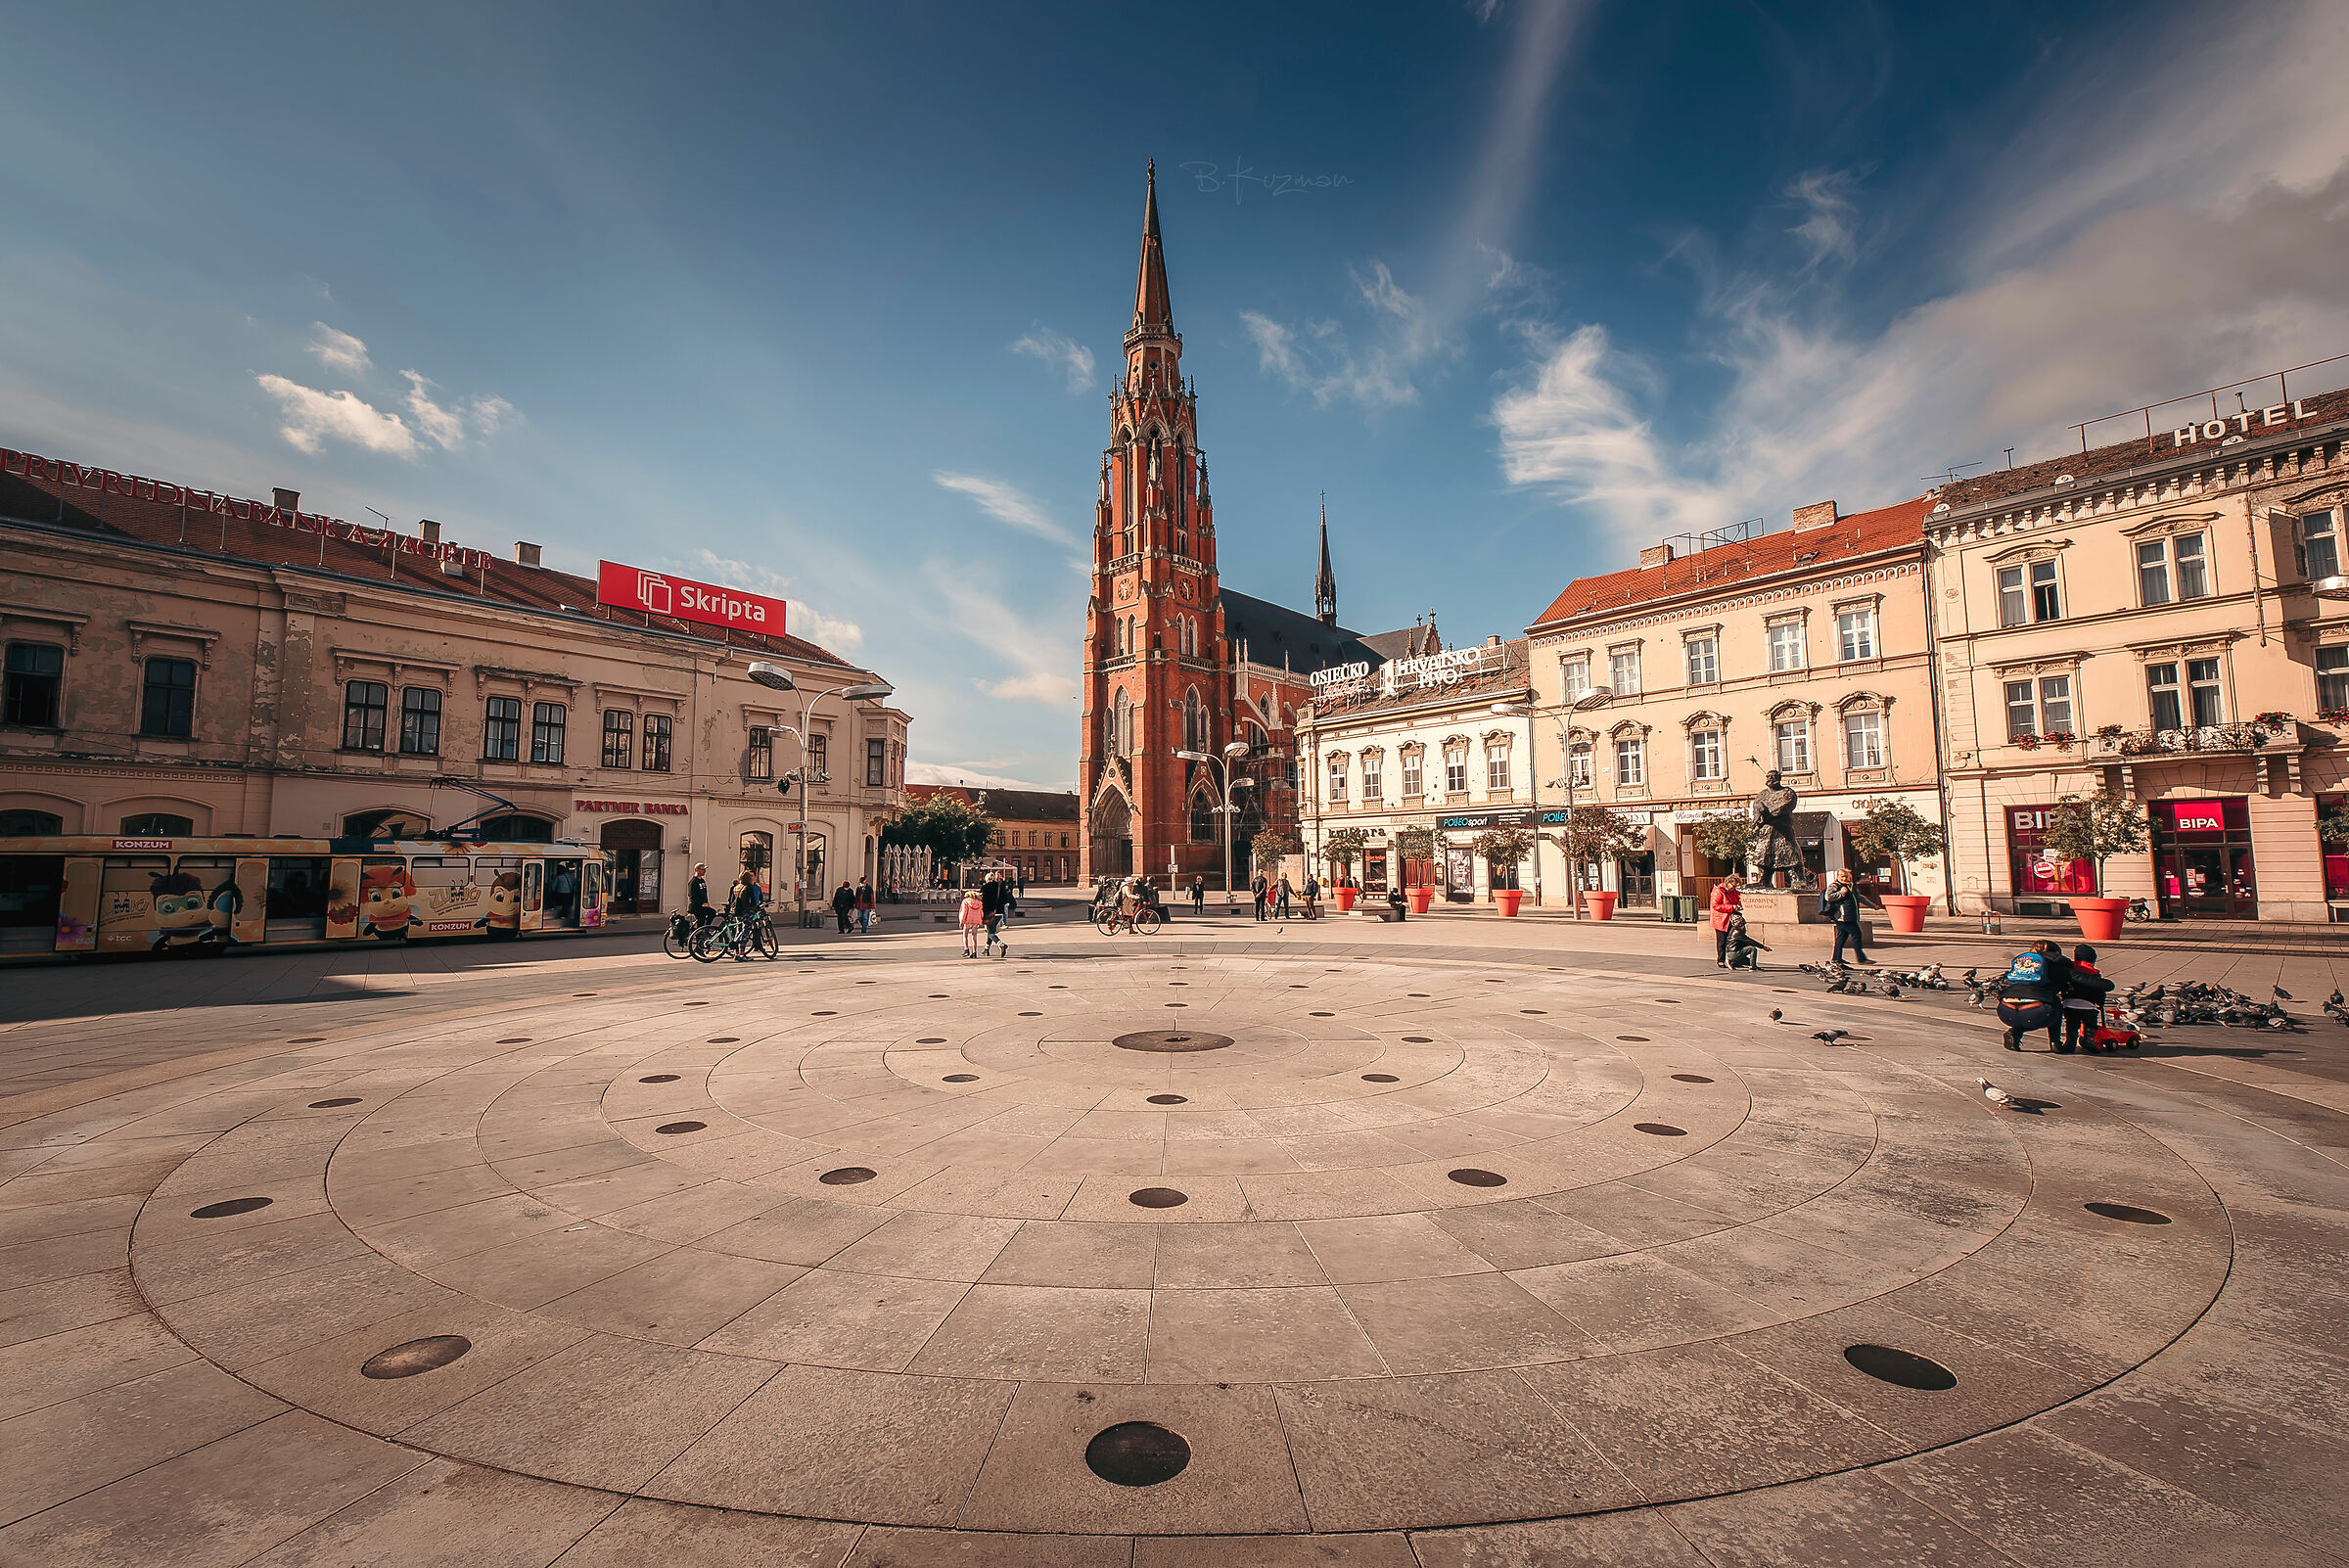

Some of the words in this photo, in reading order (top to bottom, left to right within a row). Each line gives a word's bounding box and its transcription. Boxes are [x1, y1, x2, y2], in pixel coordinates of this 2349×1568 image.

[2174, 400, 2317, 447] HOTEL
[0, 447, 239, 518] PRIVREDNA
[246, 499, 369, 546] BANKA
[375, 529, 494, 571] ZAGREB
[680, 585, 765, 623] Skripta
[1419, 669, 1458, 689] PIVO
[575, 800, 640, 813] PARTNER
[644, 803, 689, 814] BANKA
[2014, 811, 2071, 830] BIP
[2179, 817, 2219, 829] BIPA
[115, 841, 170, 850] KONZUM
[431, 922, 470, 931] KONZUM
